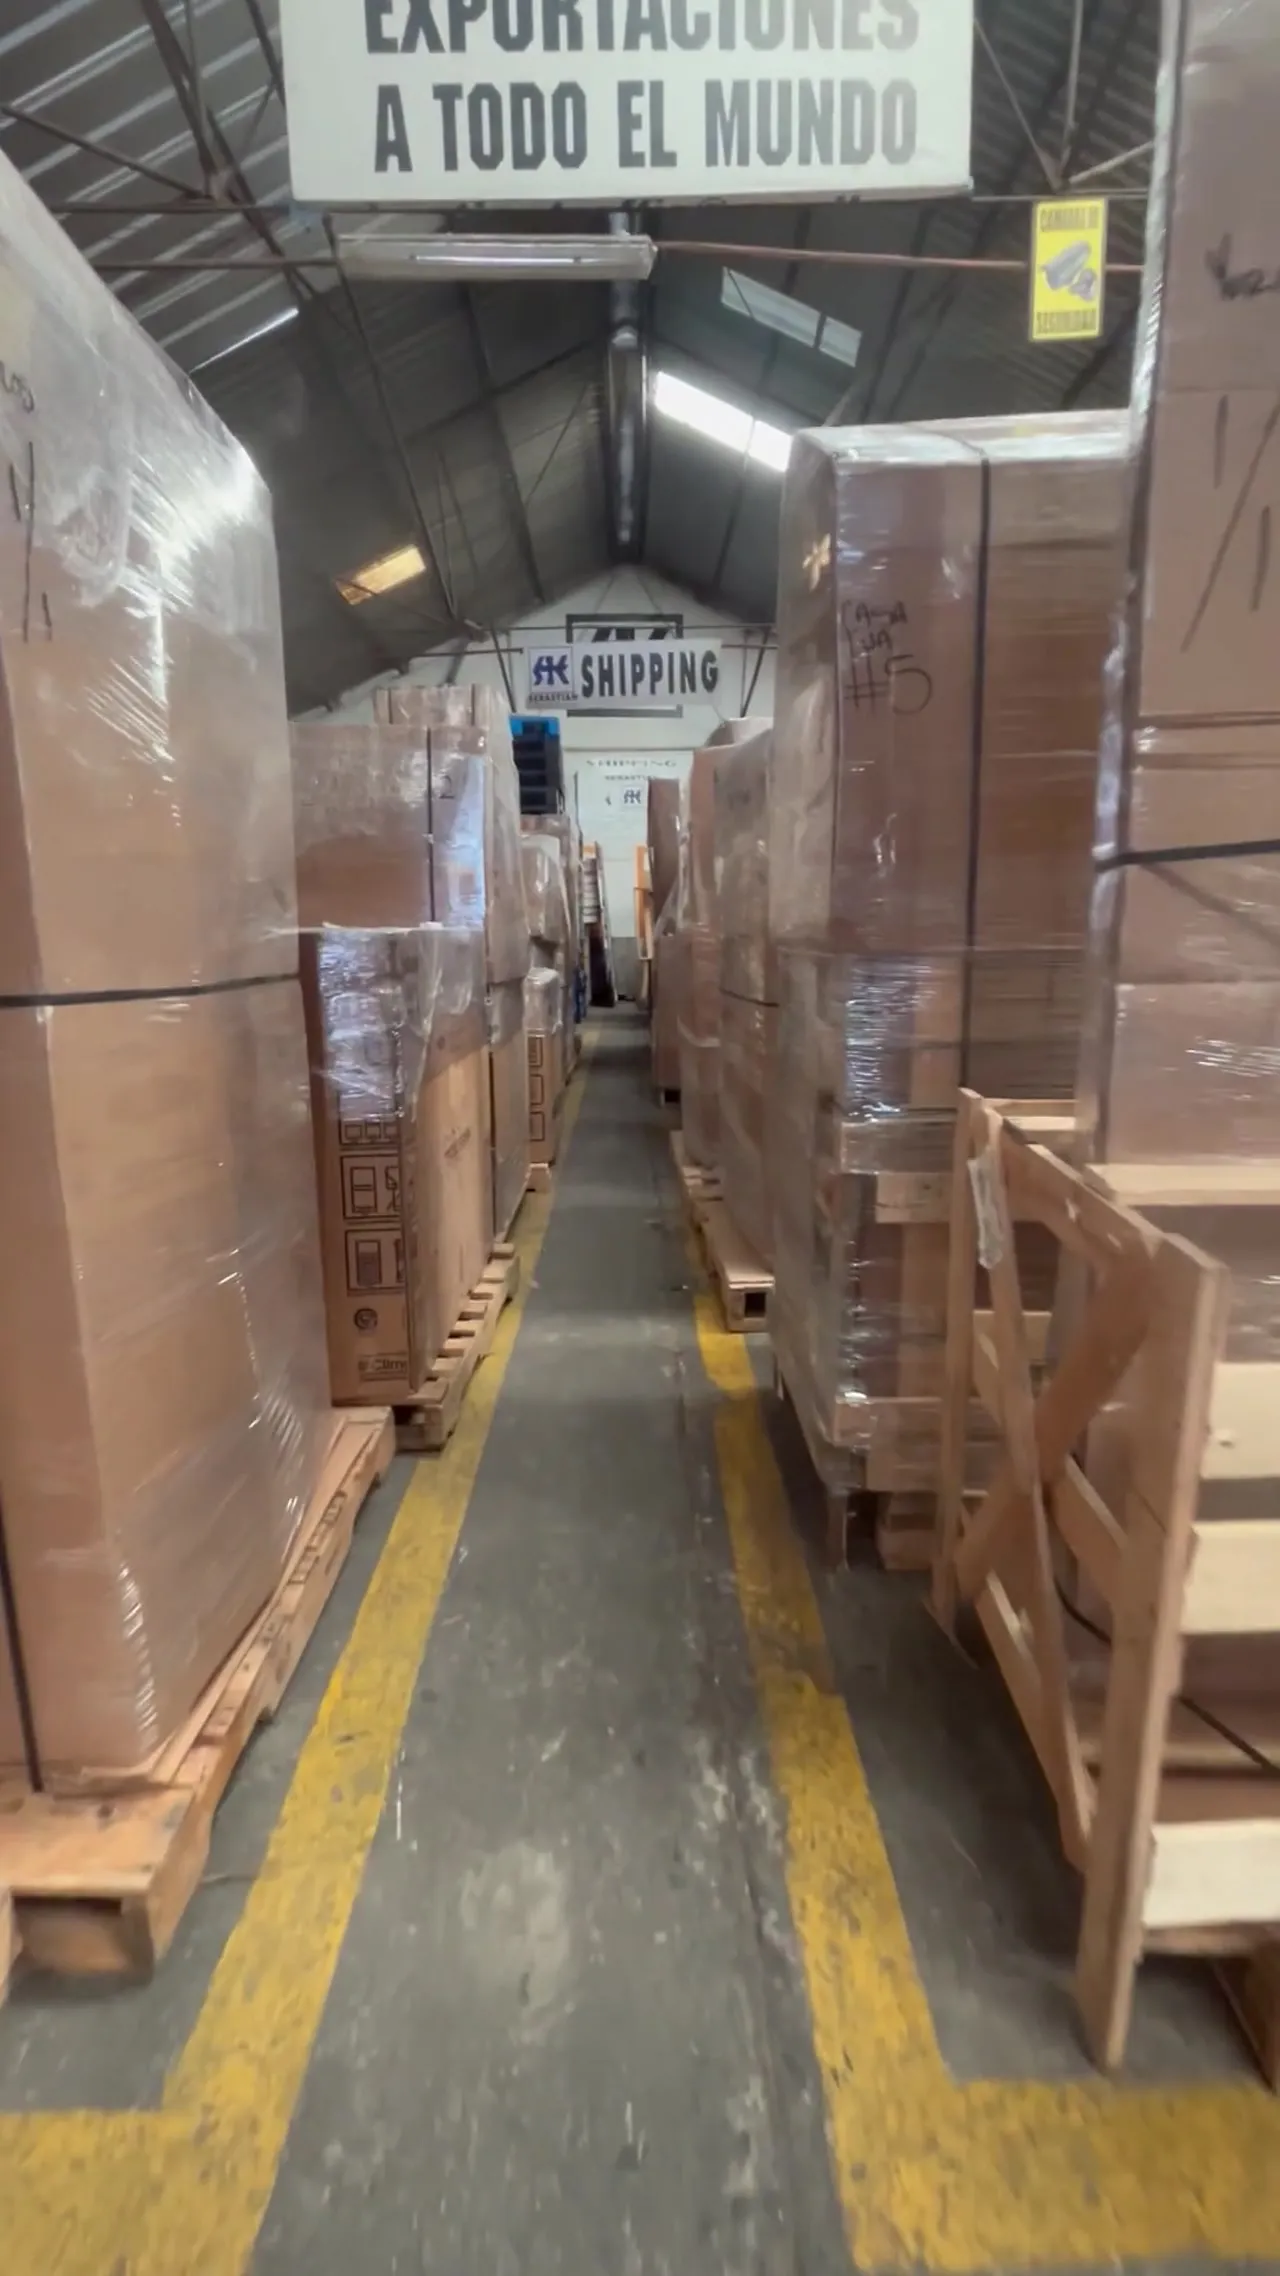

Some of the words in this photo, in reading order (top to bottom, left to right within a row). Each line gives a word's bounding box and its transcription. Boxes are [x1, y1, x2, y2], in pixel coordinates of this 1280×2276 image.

[364, 0, 919, 54] EXPORTACIONES
[374, 84, 413, 173] A
[432, 81, 588, 172] TODO
[617, 80, 677, 169] EL
[704, 77, 918, 168] MUNDO
[581, 650, 719, 698] SHIPPING
